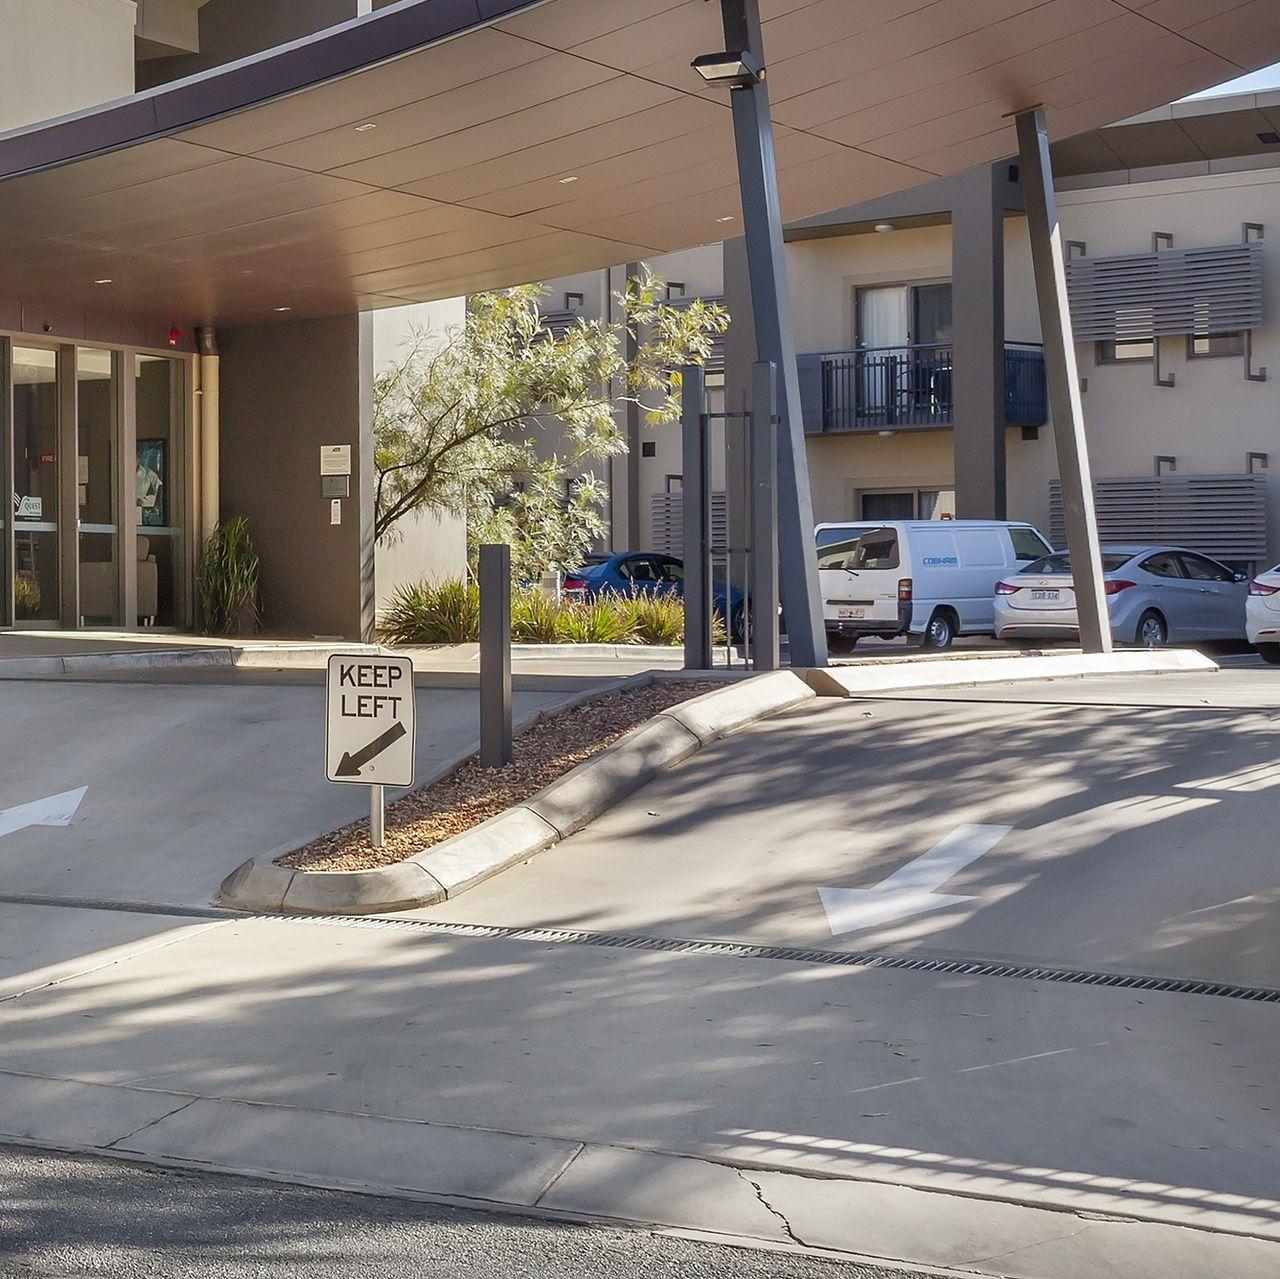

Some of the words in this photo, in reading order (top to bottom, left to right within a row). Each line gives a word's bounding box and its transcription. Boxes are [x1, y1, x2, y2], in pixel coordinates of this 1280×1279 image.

[923, 557, 958, 565] COBHAM
[340, 664, 403, 688] KEEP
[341, 694, 402, 719] LEFT
